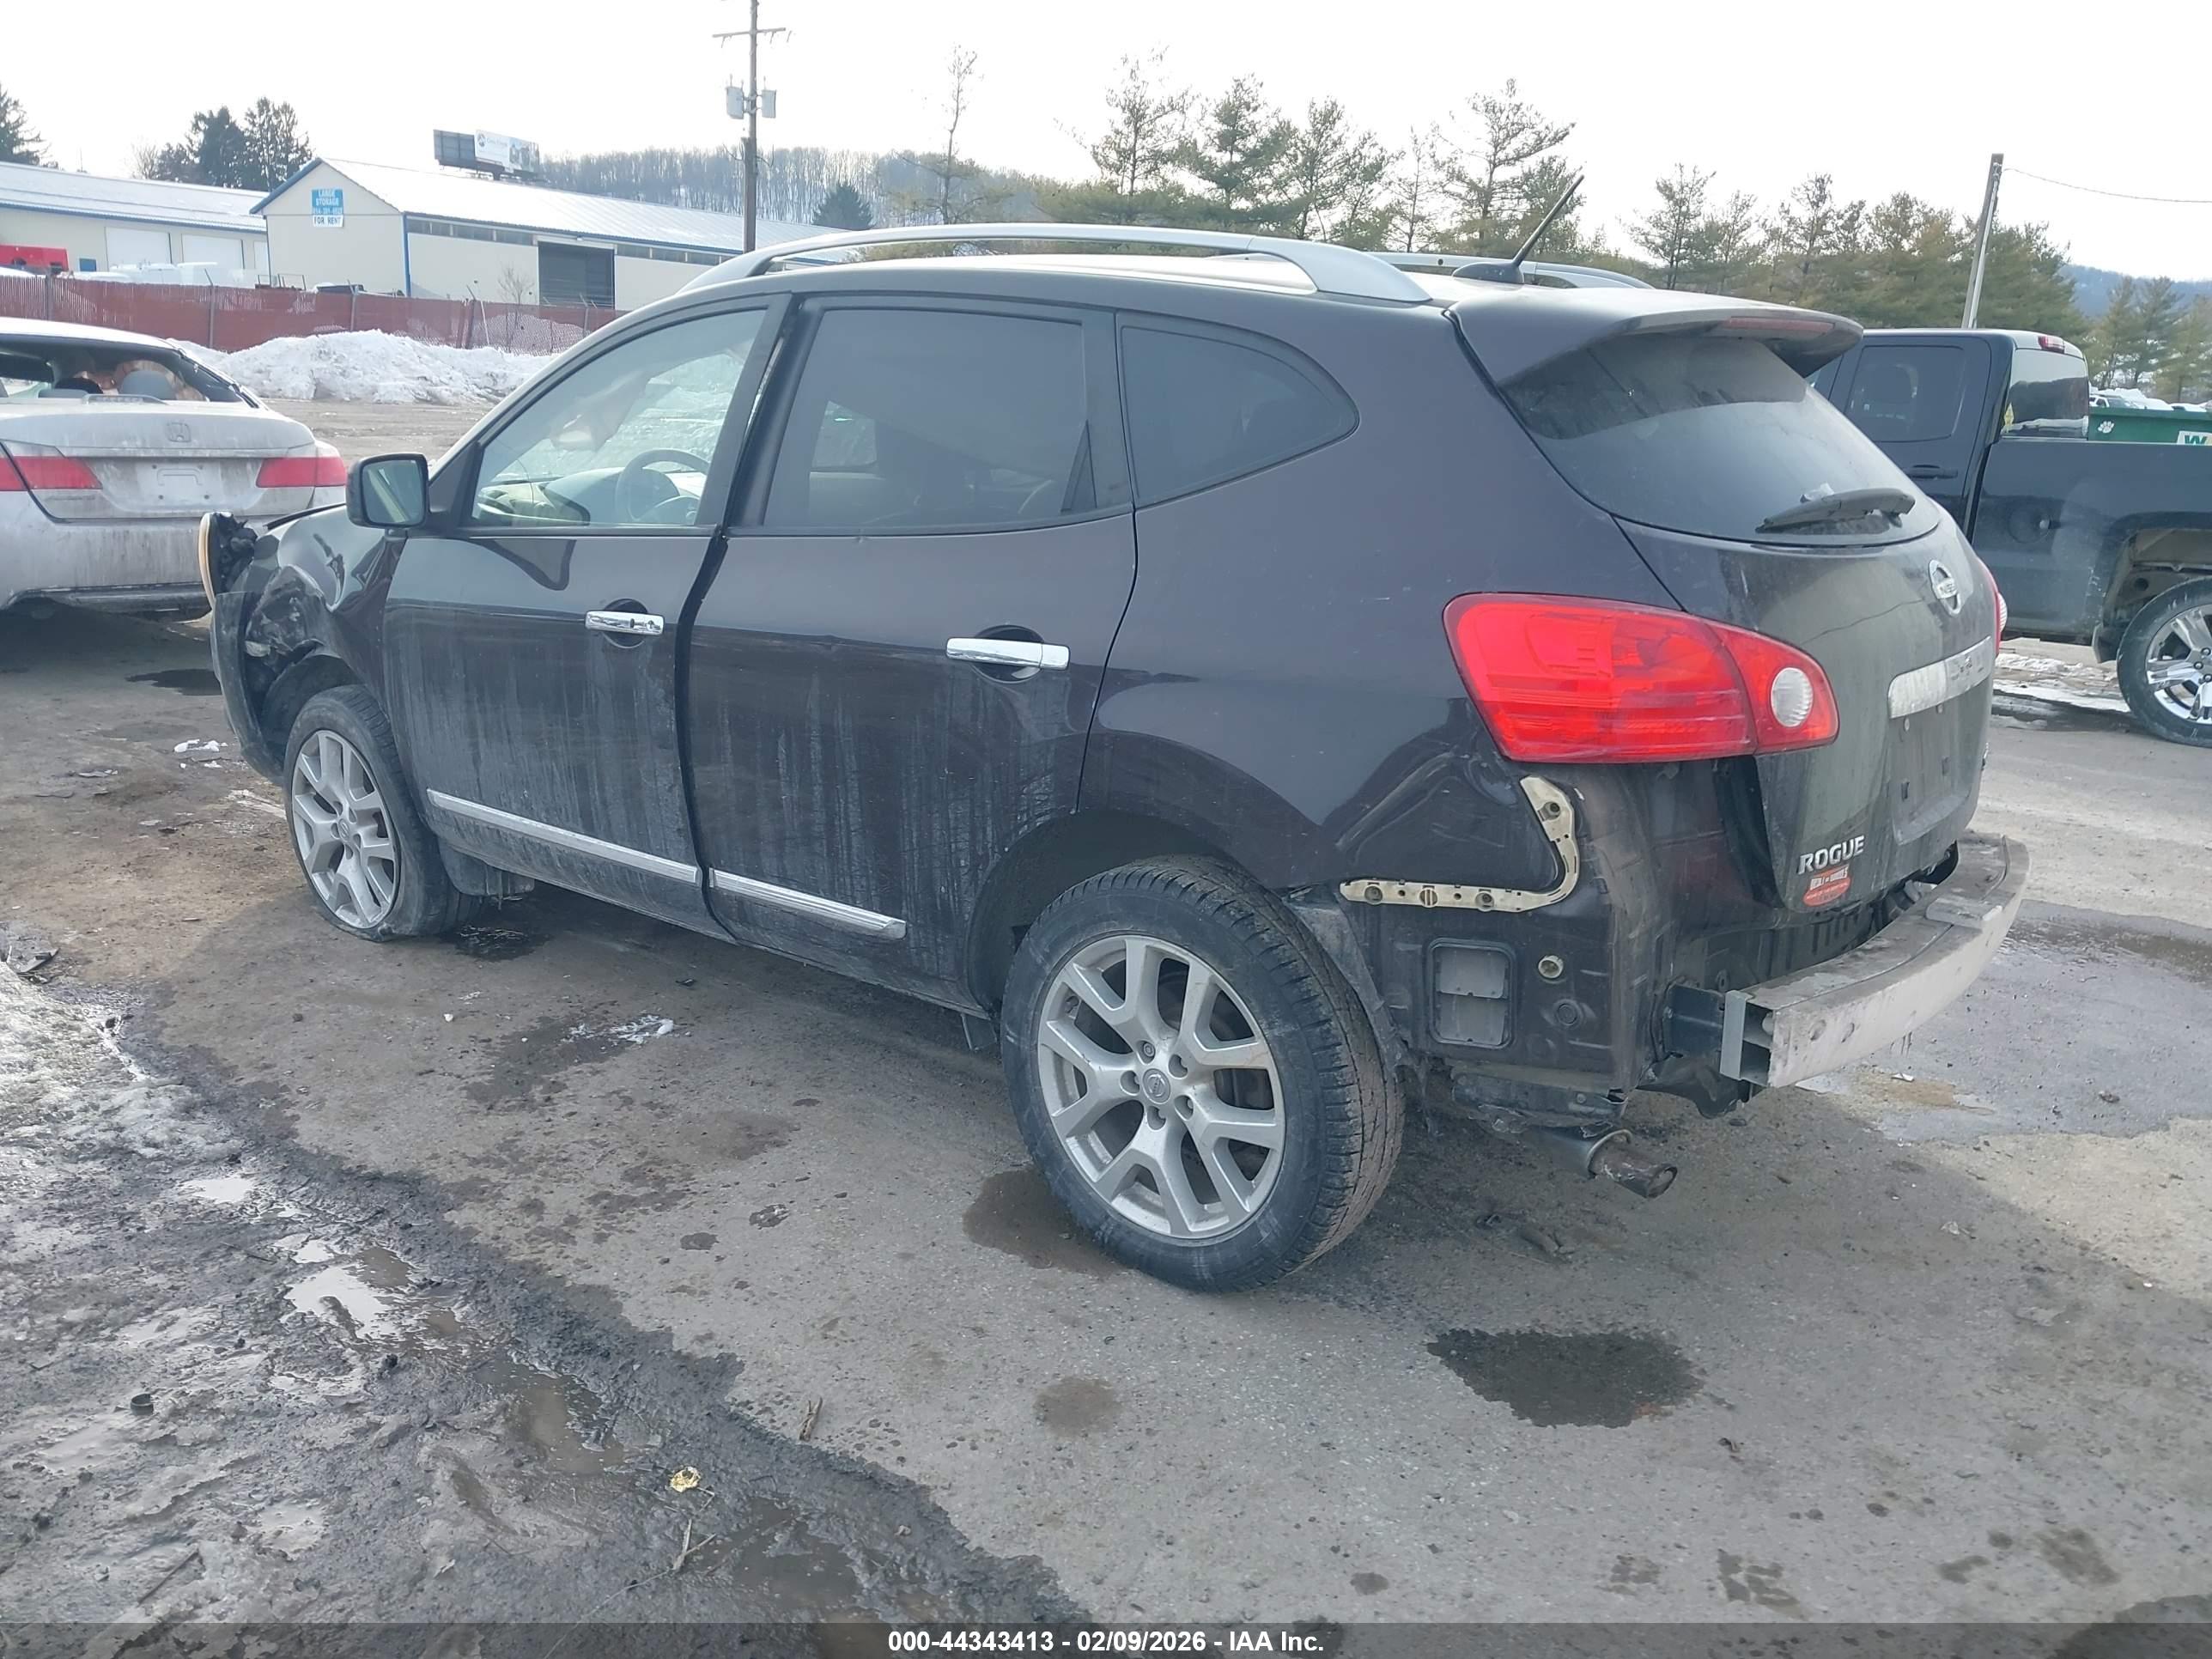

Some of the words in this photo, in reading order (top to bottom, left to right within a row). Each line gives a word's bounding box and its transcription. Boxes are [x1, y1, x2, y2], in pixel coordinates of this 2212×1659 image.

[313, 216, 325, 225] FOR
[327, 216, 342, 225] RENT
[1797, 835, 1865, 875] ROGUE
